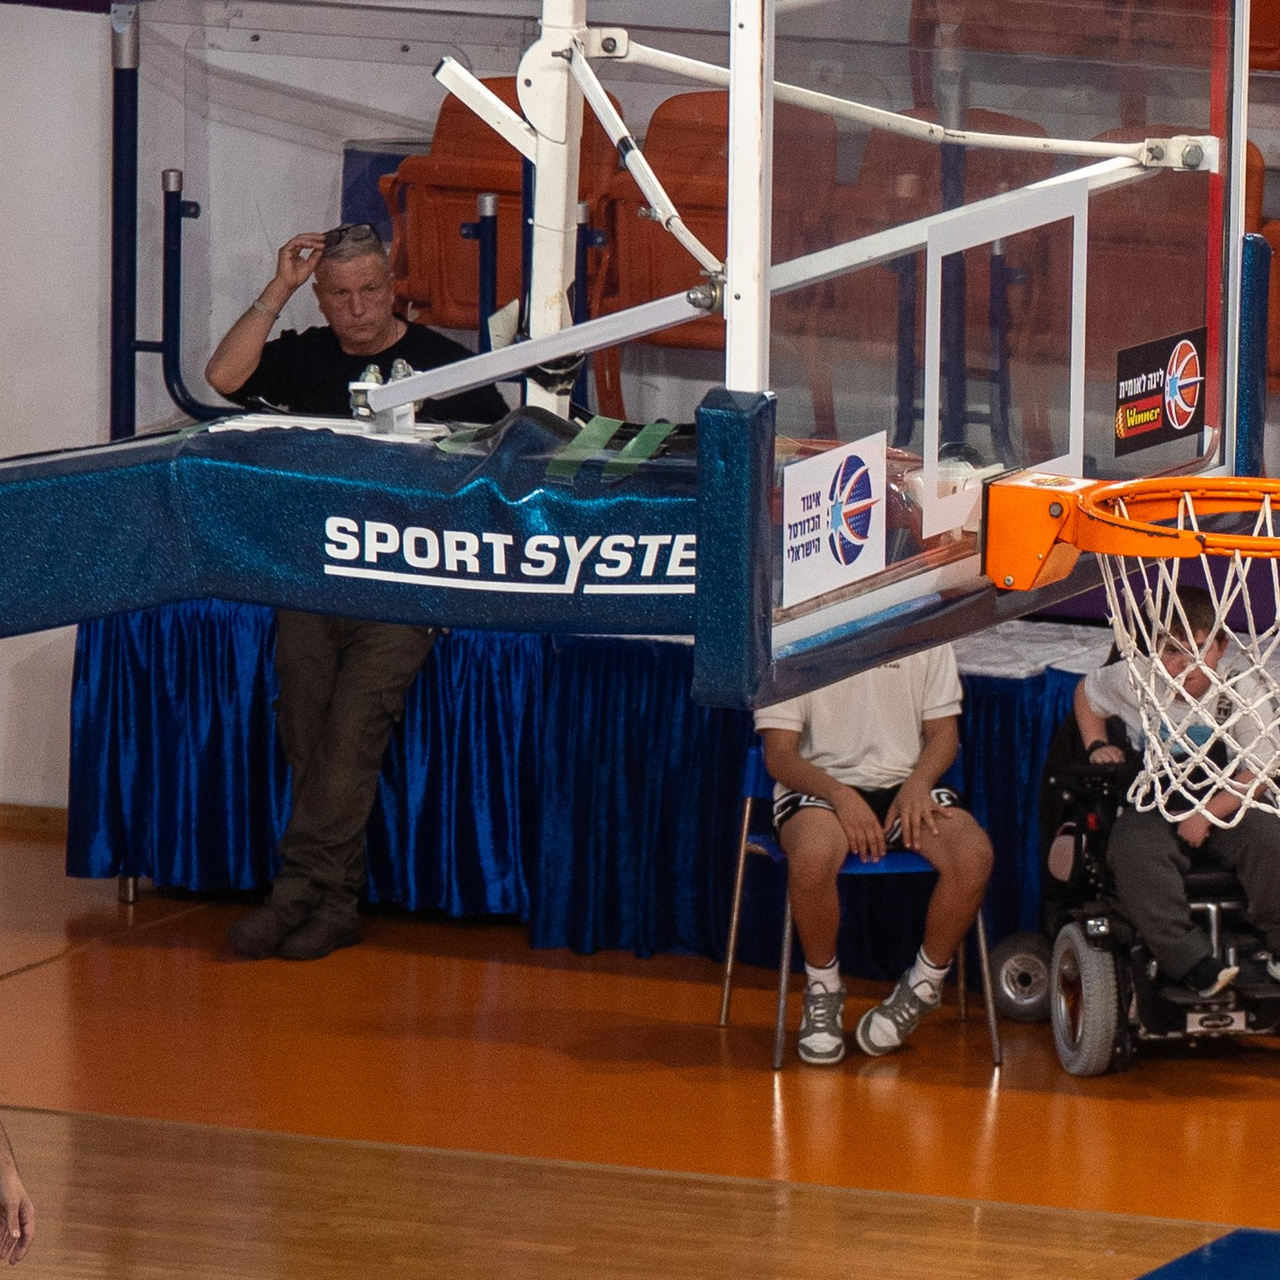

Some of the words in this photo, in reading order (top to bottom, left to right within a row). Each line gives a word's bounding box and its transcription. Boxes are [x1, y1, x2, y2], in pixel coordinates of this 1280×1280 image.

[1119, 373, 1147, 399] לאומית
[1147, 367, 1165, 391] ליגה
[801, 490, 821, 512] איגוד
[788, 514, 821, 540] הכדורסל
[324, 516, 514, 575] SPORT
[520, 534, 696, 594] SYSTE
[787, 537, 820, 563] הישראלי
